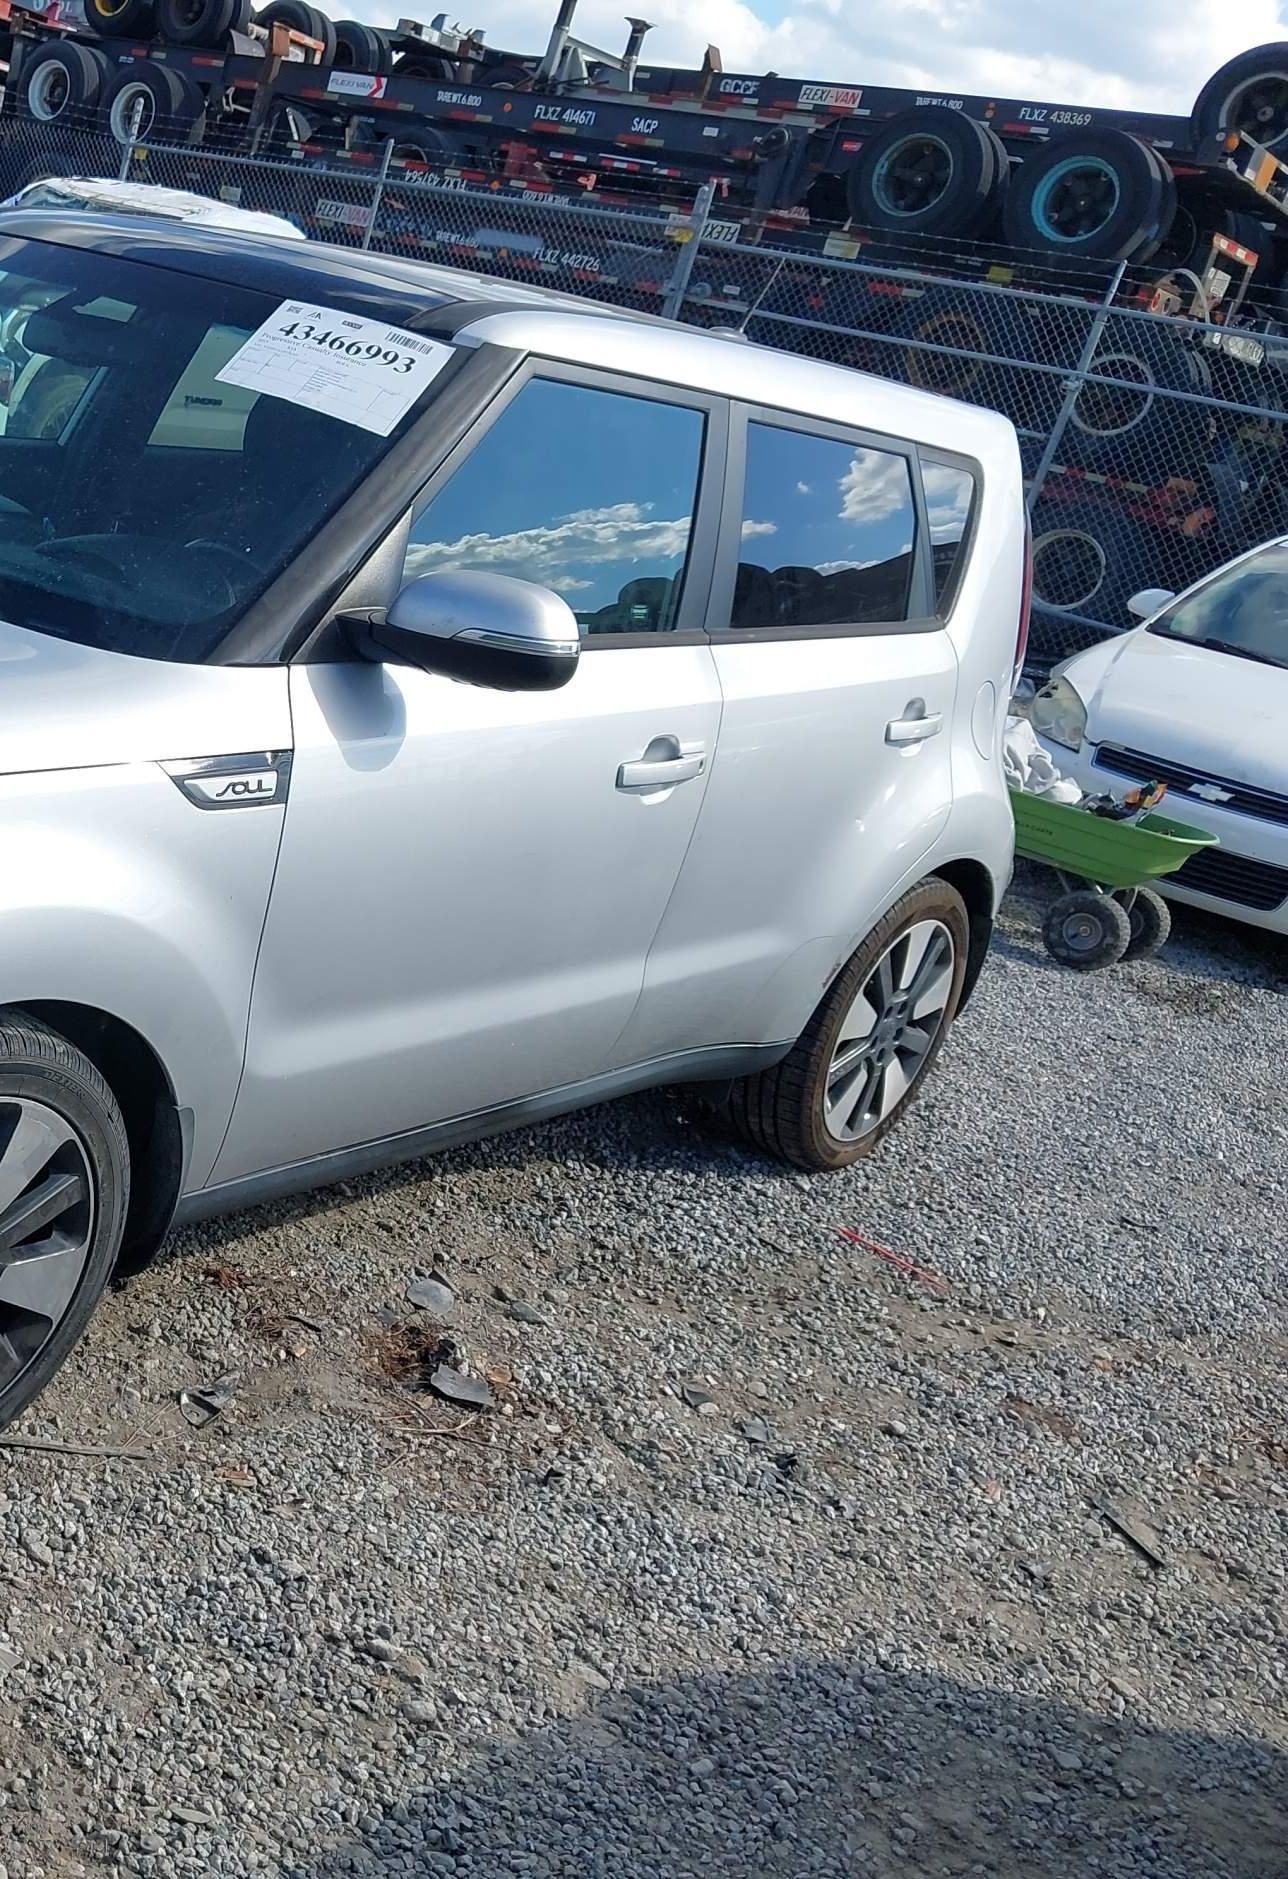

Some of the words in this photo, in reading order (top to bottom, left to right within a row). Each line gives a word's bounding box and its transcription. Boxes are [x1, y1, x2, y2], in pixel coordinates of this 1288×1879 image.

[800, 86, 860, 105] FLEXI-VAN
[534, 104, 561, 120] FLXZ
[562, 108, 597, 126] 414671
[1019, 107, 1048, 122] FLXZ
[1049, 110, 1092, 126] 438369
[631, 117, 659, 134] SACP
[532, 246, 561, 263] FLXZ
[561, 252, 601, 271] 442726
[279, 321, 417, 374] 43466993
[215, 779, 273, 798] SOUL
